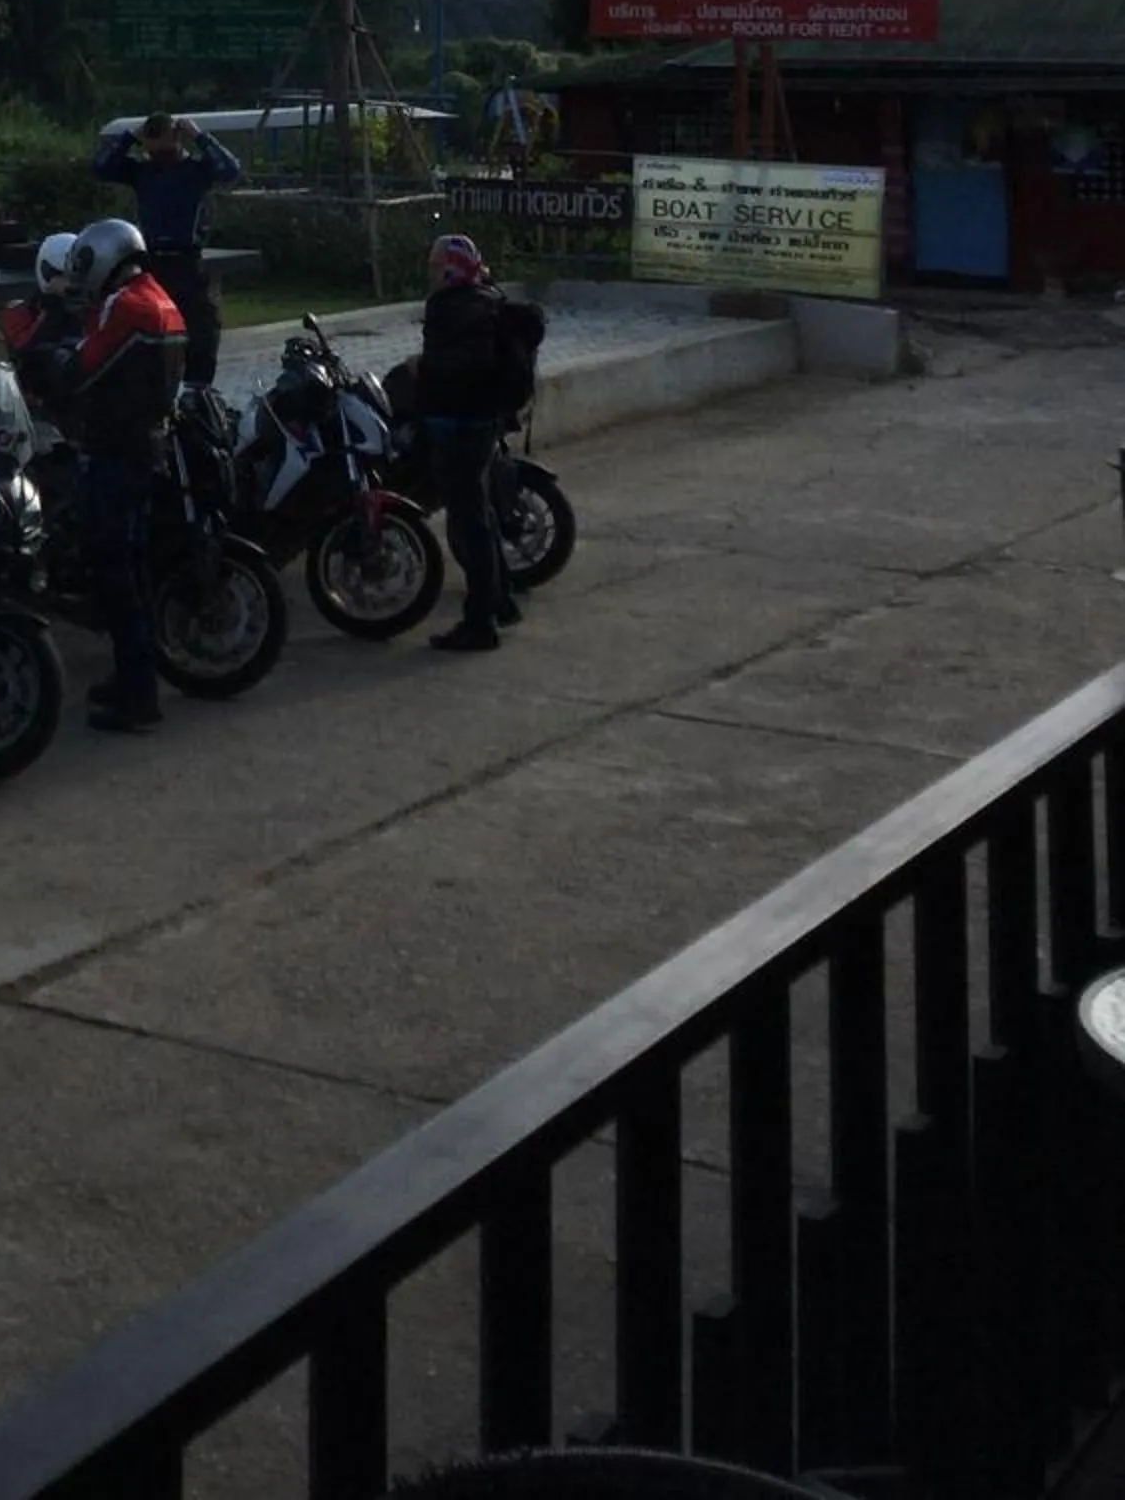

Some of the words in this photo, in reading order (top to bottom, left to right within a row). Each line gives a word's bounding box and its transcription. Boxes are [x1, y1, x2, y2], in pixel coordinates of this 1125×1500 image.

[608, 3, 657, 19] บริการ
[731, 22, 784, 36] ROOM
[789, 22, 824, 36] FOR
[828, 23, 873, 37] RENT
[693, 177, 707, 192] &
[653, 199, 718, 220] BOAT
[733, 204, 853, 230] SERVICE
